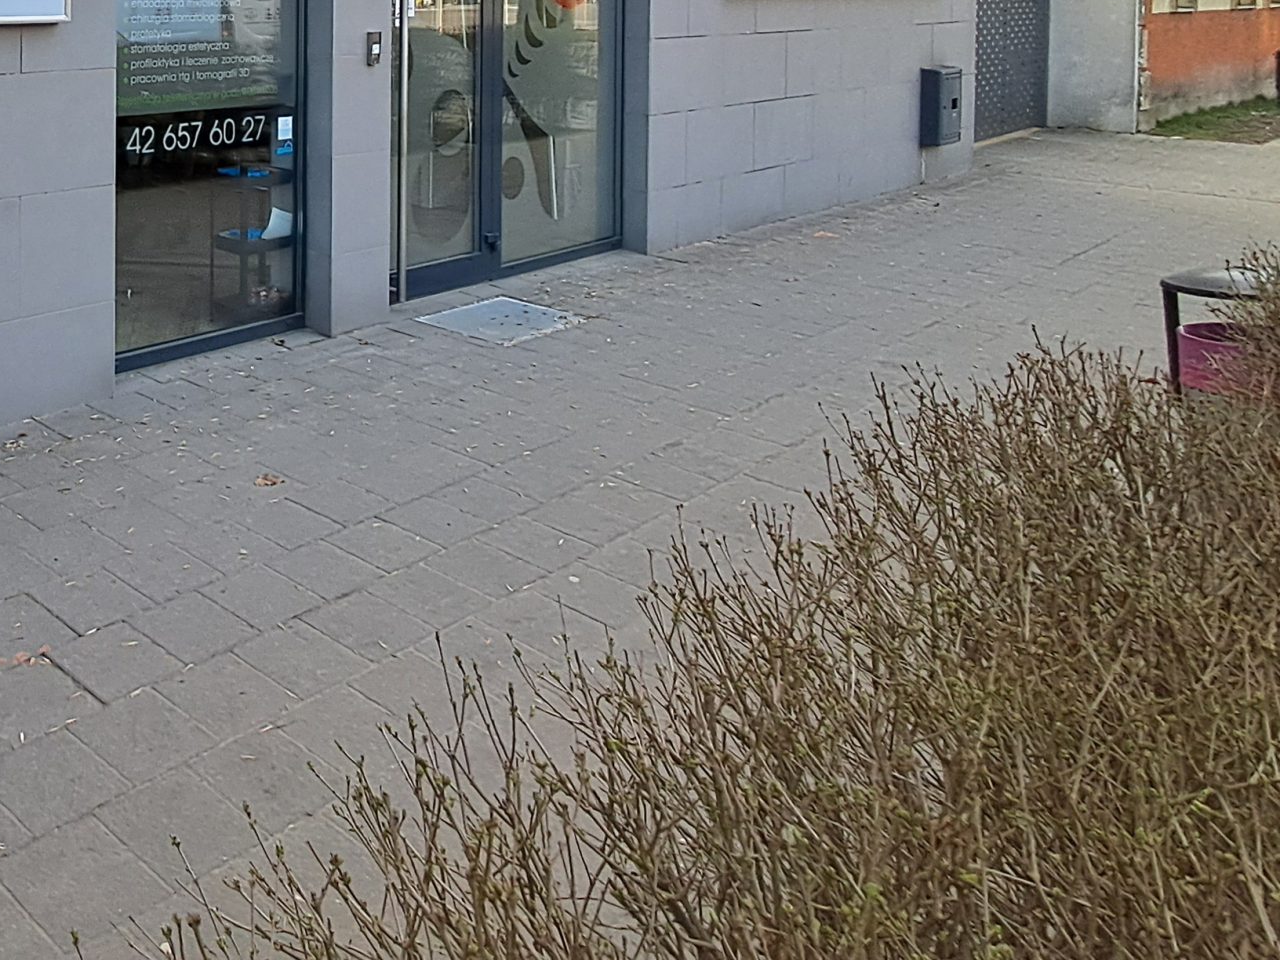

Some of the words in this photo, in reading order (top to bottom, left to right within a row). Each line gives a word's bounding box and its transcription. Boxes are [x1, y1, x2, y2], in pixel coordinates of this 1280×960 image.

[126, 126, 155, 154] 42
[162, 121, 203, 151] 657
[209, 118, 237, 146] 60
[242, 115, 267, 143] 27
